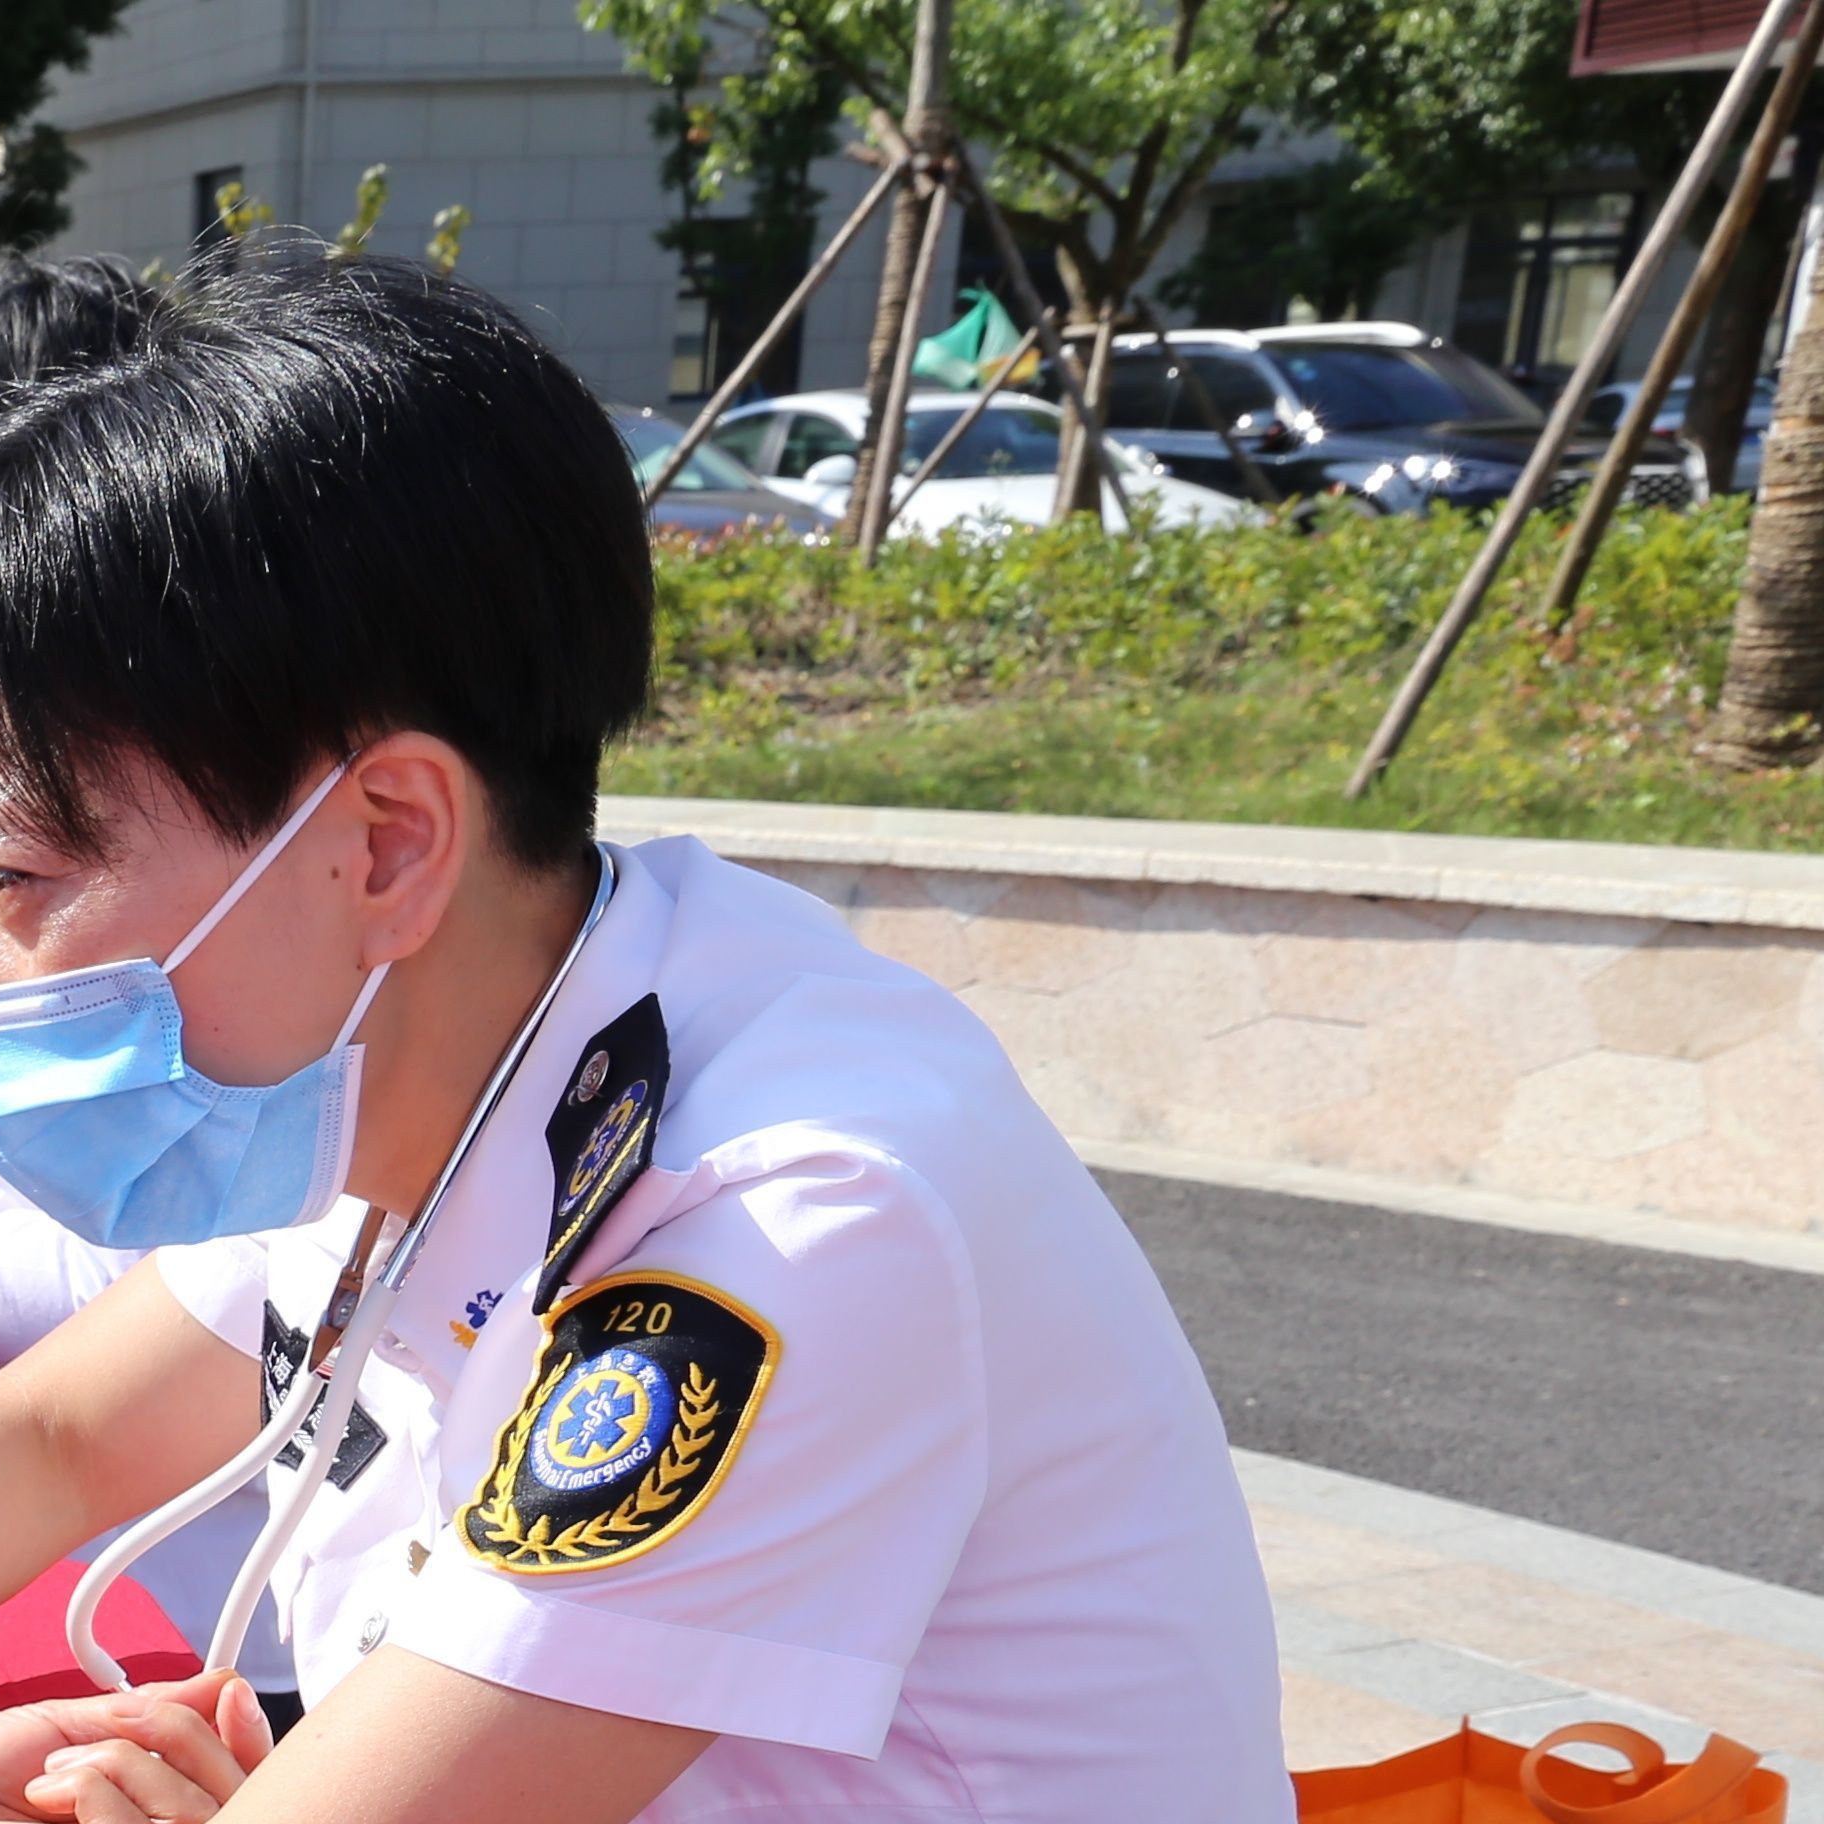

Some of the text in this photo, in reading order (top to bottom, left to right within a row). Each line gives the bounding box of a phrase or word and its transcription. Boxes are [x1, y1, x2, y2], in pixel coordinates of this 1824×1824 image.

[603, 1301, 673, 1335] 120
[573, 1352, 658, 1390] 上海急救
[558, 1435, 653, 1490] Emergency
